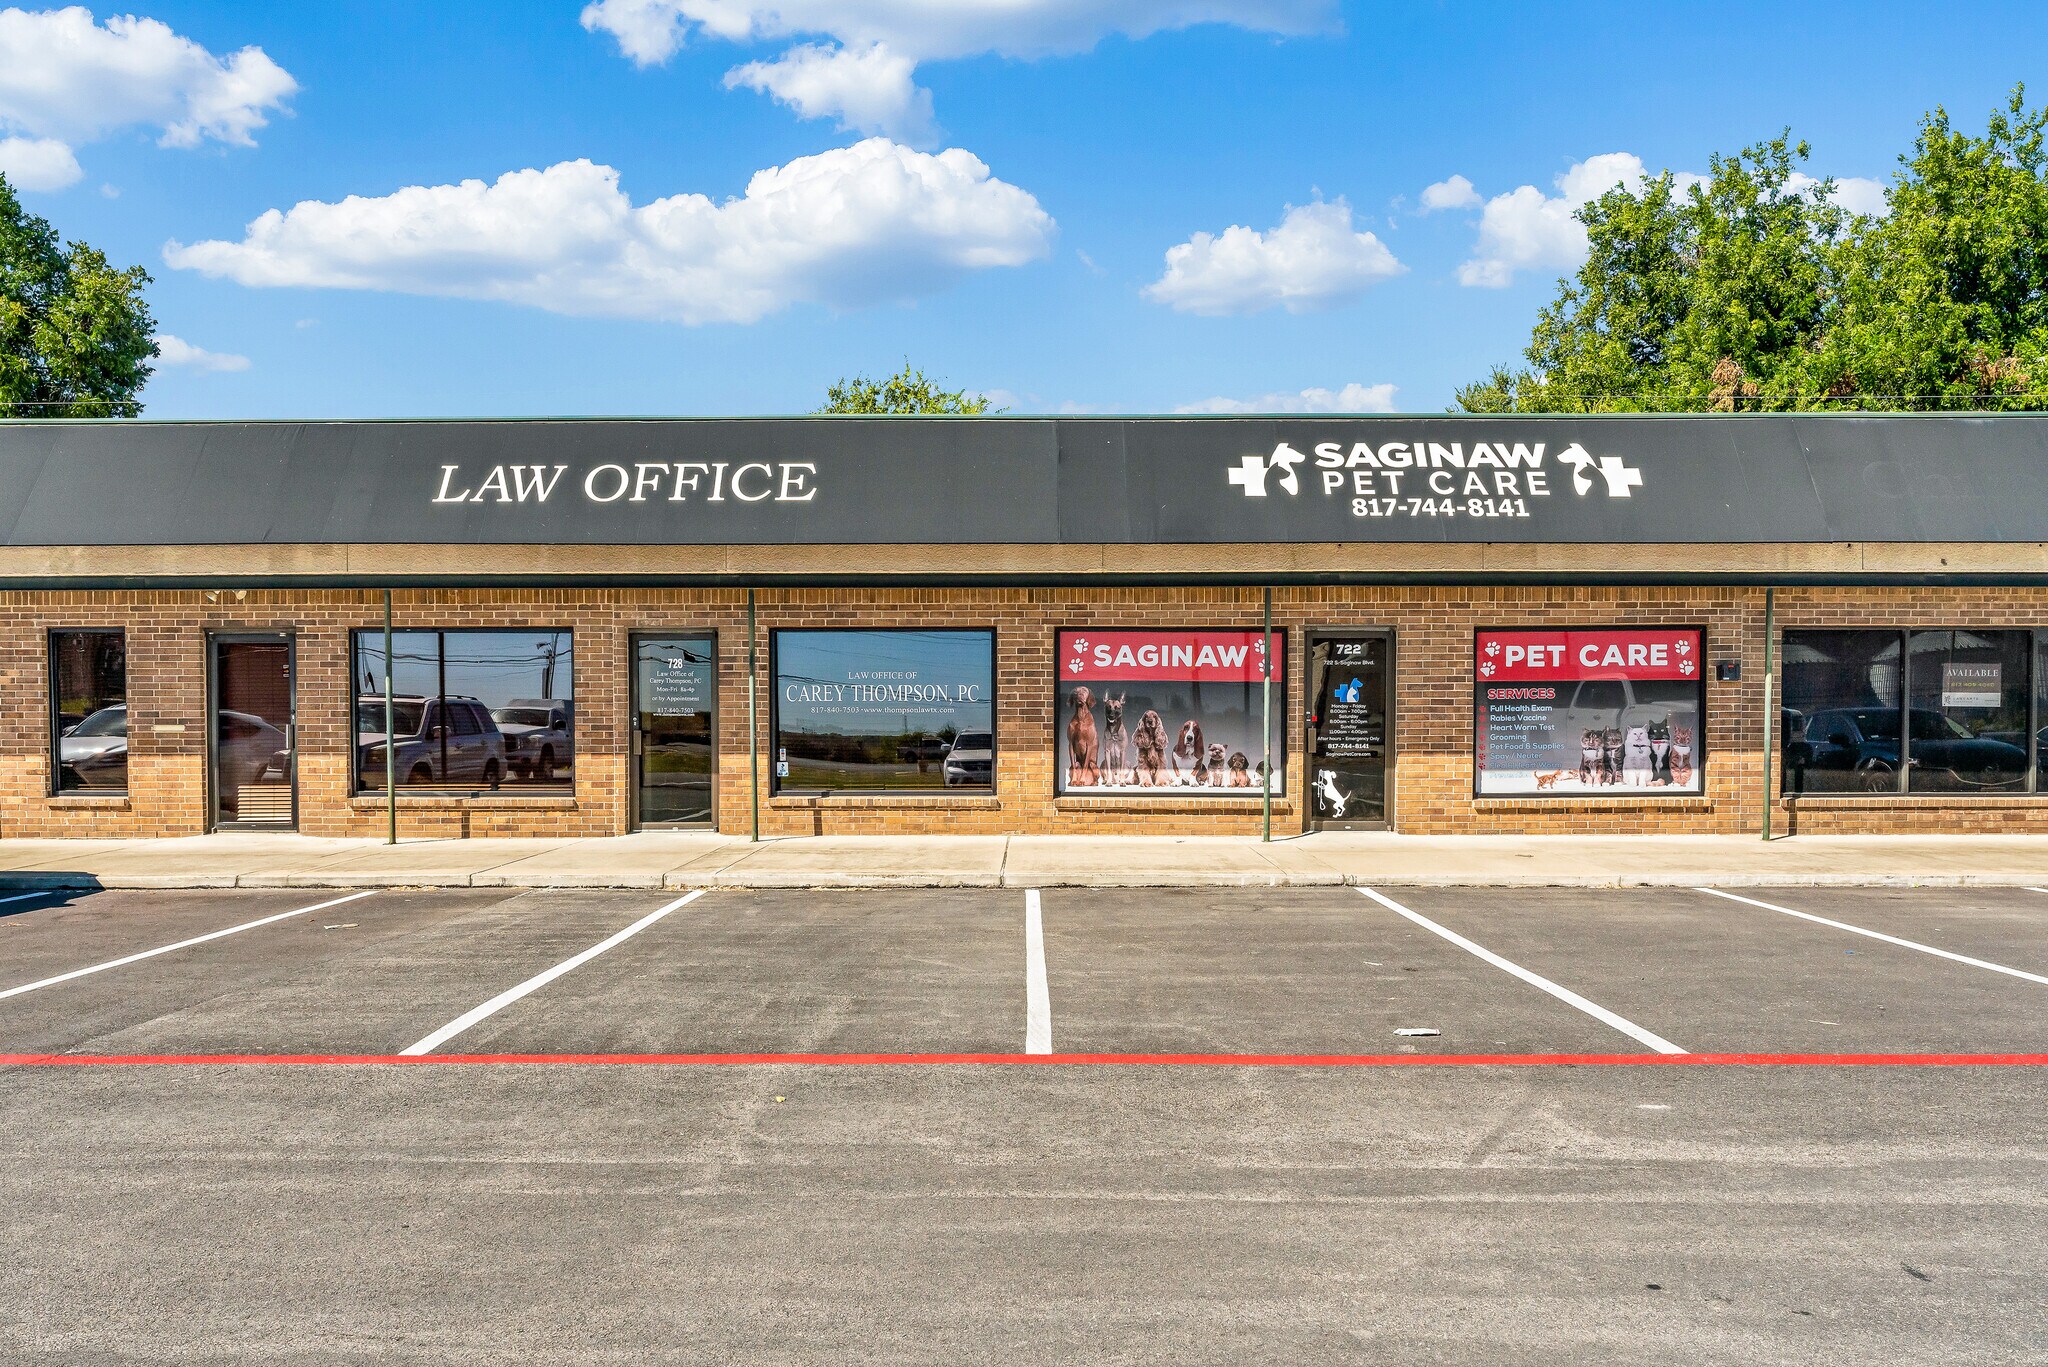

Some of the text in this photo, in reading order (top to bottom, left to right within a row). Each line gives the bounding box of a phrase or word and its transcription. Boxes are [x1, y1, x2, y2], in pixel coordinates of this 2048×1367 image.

[1314, 442, 1546, 468] SAGINAW
[432, 463, 817, 502] LAW OFFICE
[1322, 470, 1550, 496] PET CARE
[1352, 498, 1530, 517] 817-744-8141
[1336, 644, 1362, 655] 722
[1505, 644, 1668, 667] PET CARE
[1093, 644, 1249, 668] SAGINAW
[667, 658, 683, 669] 728
[848, 671, 917, 680] LAW OFFICE OF
[1946, 669, 1999, 677] AVAILABLE
[666, 677, 693, 685] Thompson,
[786, 684, 979, 705] CAREY THOMPSON, PC
[1487, 688, 1556, 700] SERVICES
[1490, 733, 1527, 742] Grooming
[1532, 743, 1565, 751] Supplies
